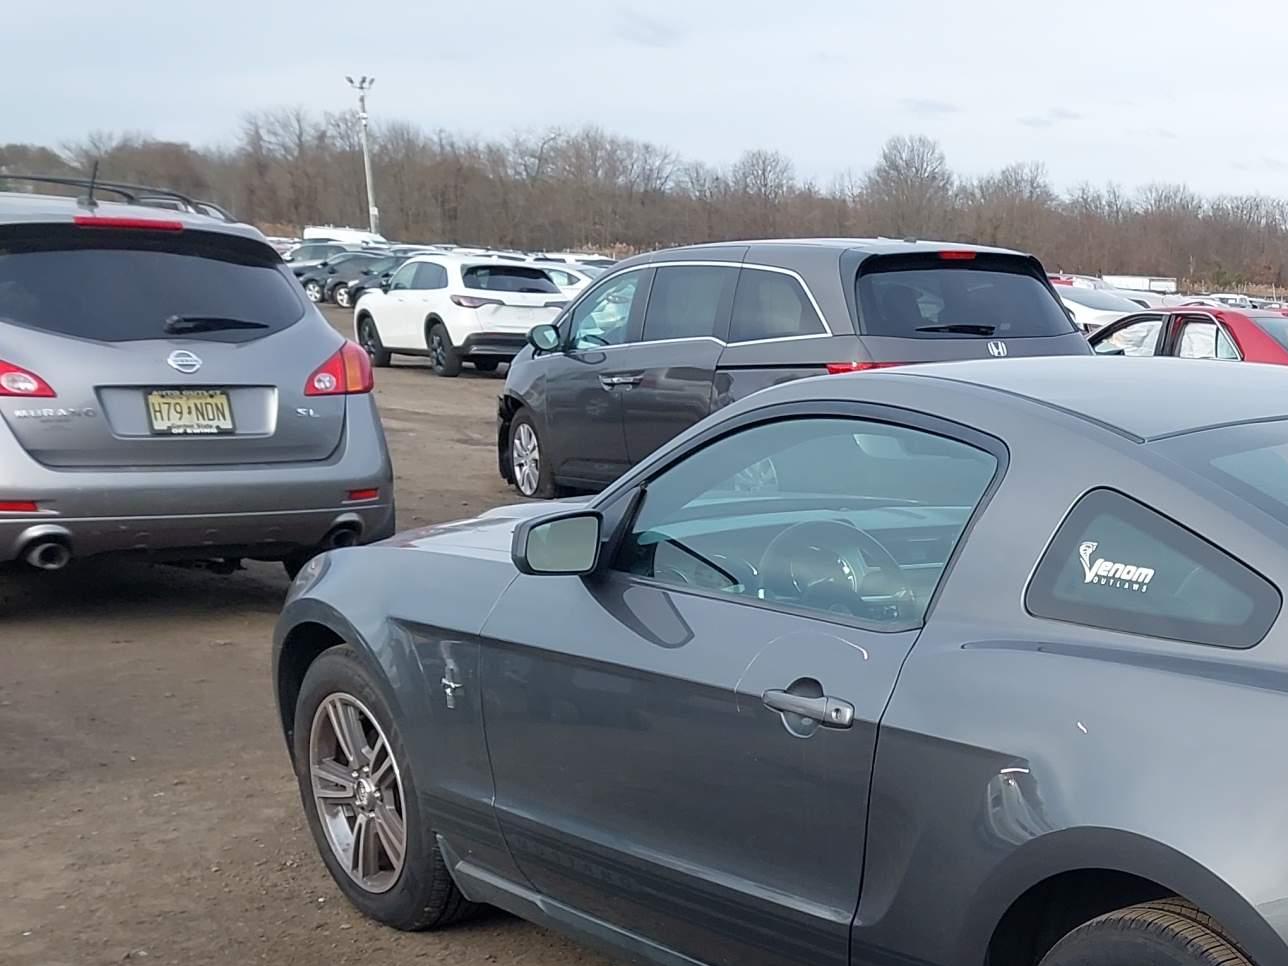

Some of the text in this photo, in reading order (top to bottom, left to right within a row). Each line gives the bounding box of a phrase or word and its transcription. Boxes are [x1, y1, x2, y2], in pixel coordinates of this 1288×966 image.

[152, 402, 226, 421] H79 NDN
[296, 408, 320, 418] SL
[1080, 541, 1155, 584] Venom
[1092, 576, 1148, 593] OUTLAWS
